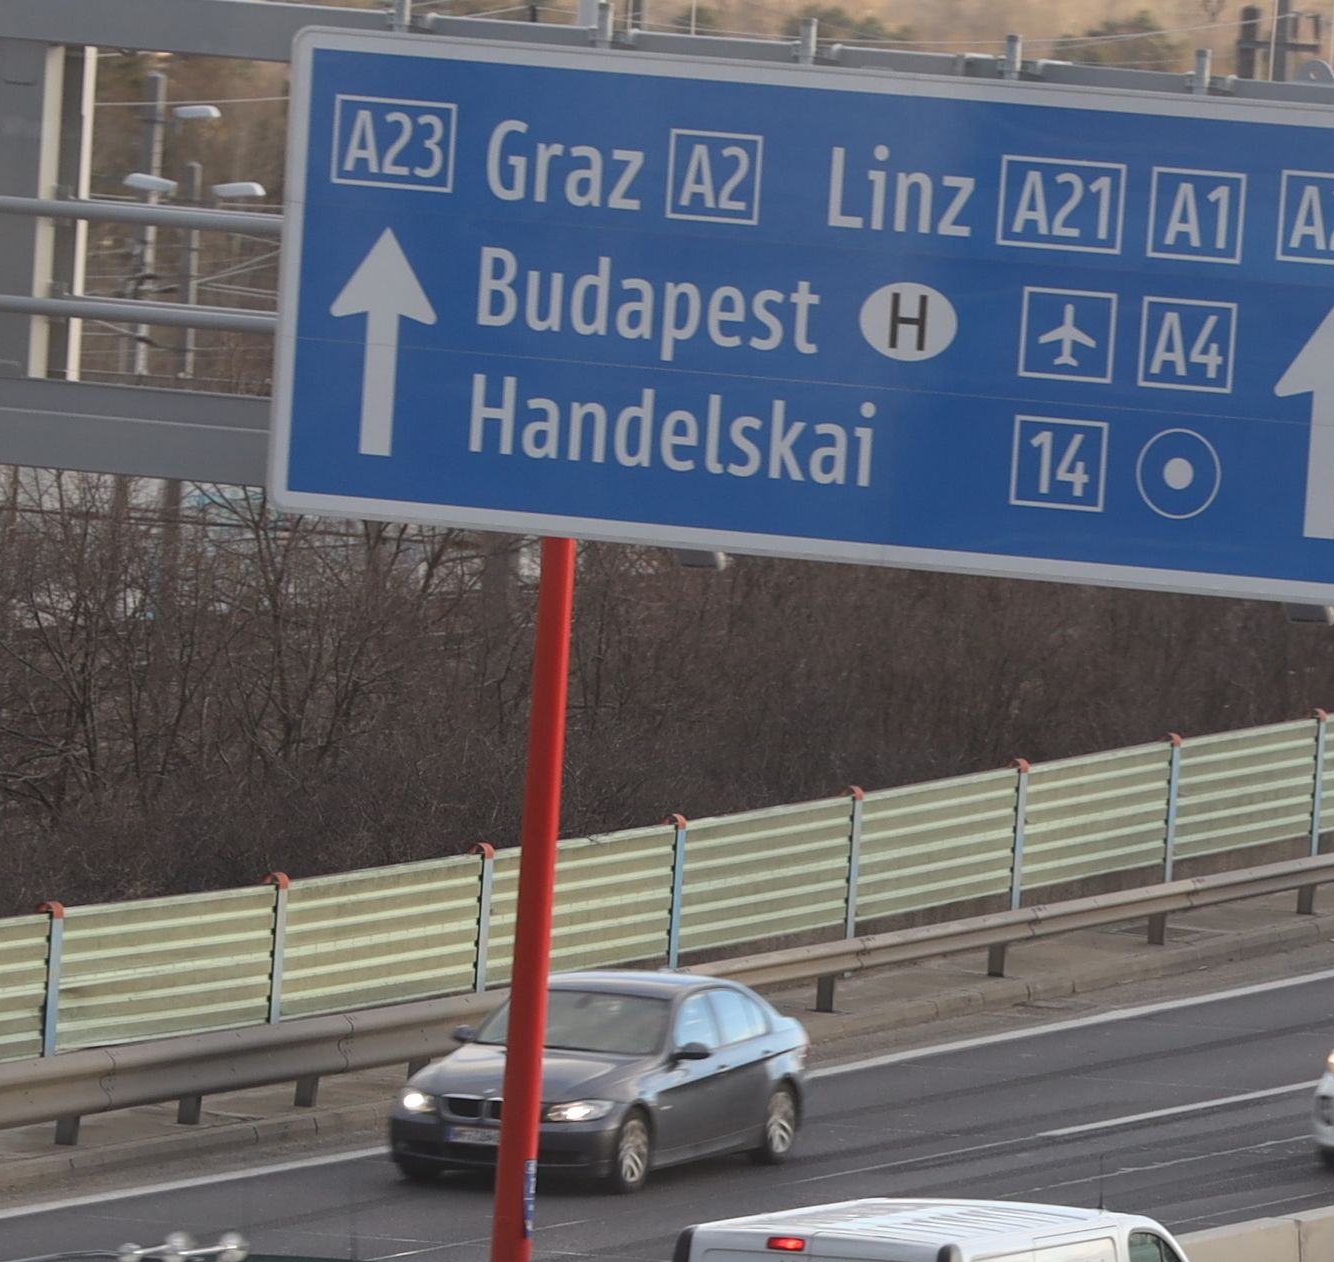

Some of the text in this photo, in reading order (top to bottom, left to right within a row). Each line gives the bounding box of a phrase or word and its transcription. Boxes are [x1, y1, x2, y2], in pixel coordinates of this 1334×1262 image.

[343, 109, 444, 178] A23
[486, 119, 645, 211] Graz
[679, 143, 750, 211] A2
[827, 144, 975, 237] Linz
[1011, 170, 1112, 240] A21
[1163, 182, 1230, 249] A1
[477, 246, 1223, 379] Budapest H A4
[469, 373, 1089, 497] Handelskai 14
